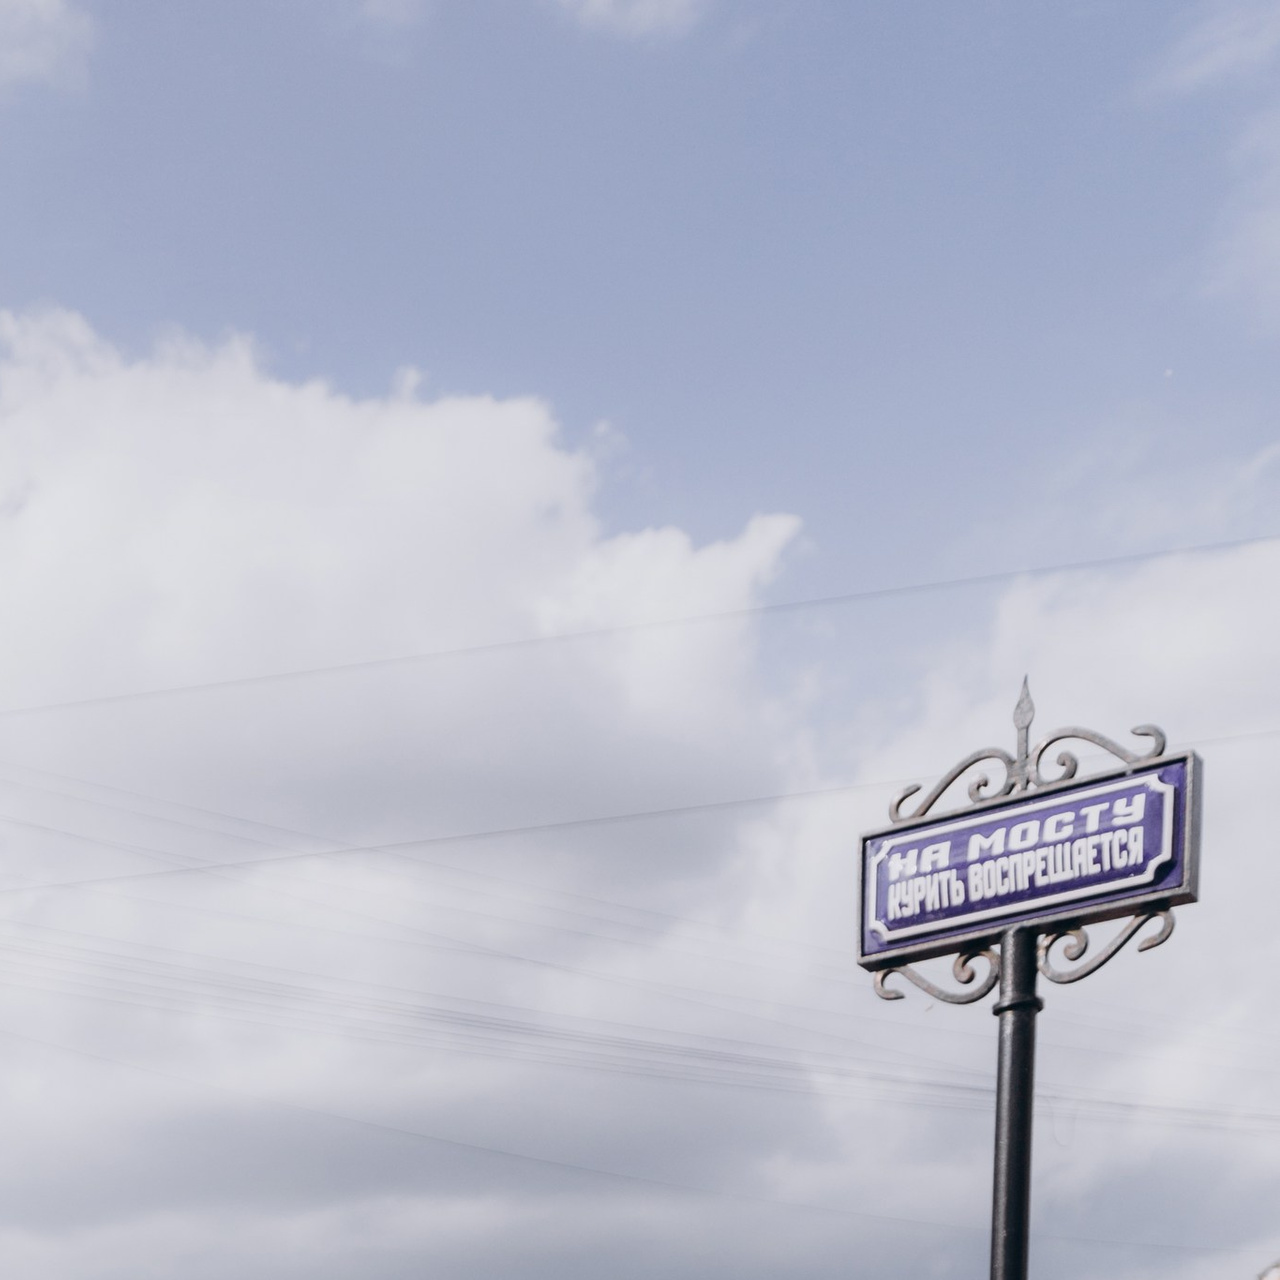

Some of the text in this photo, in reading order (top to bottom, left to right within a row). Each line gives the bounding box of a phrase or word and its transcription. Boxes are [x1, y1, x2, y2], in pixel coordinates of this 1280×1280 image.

[887, 826, 1145, 921] КУРИТЬ ВОСПРЕЩАЕТСЯ
[888, 793, 1146, 881] НА МОСТУ
